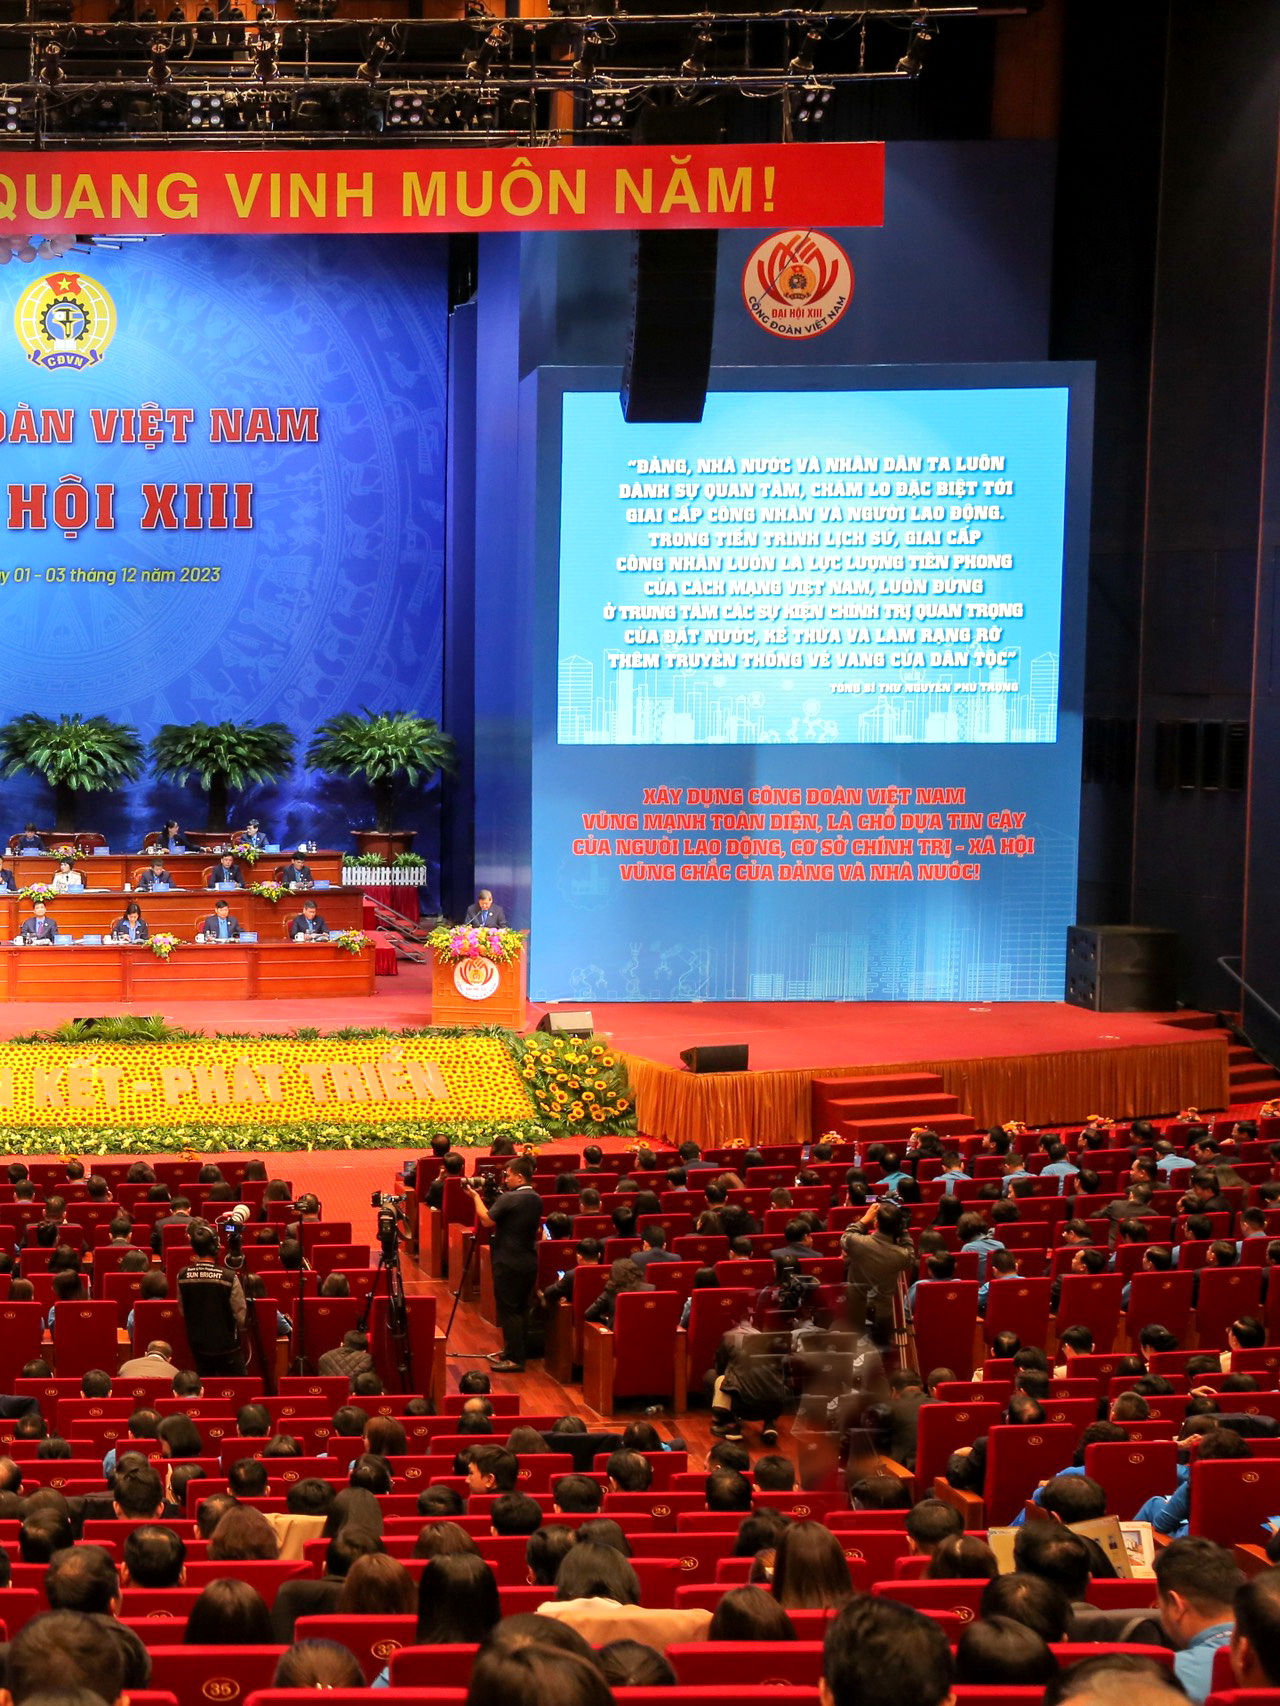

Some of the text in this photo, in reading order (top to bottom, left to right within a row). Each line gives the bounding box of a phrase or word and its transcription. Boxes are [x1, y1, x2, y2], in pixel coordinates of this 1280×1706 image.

[225, 173, 372, 218] VINH
[403, 157, 585, 216] MUÔN
[616, 155, 774, 213] NĂM!
[748, 296, 770, 324] CÔNG
[770, 321, 802, 335] ĐOÀN
[827, 296, 846, 320] NAM
[772, 307, 822, 320] ĐẠI HỘI XIII
[47, 355, 83, 367] CĐVN
[90, 402, 193, 449] VIỆT
[210, 408, 318, 442] NAM
[698, 456, 736, 474] NHÀ
[741, 456, 791, 473] NƯỚC
[796, 456, 820, 473] VÀ
[826, 455, 879, 473] NHÂN
[884, 455, 922, 473] DÂN
[927, 458, 951, 472] TA
[956, 455, 1005, 472] LUÔN
[8, 474, 114, 538] HỘI
[141, 484, 252, 528] XIII
[649, 532, 709, 547] TRONG
[715, 526, 758, 546] TIẾN
[763, 529, 819, 546] TRÌNH
[824, 531, 865, 549] LỊCH
[905, 531, 941, 545] GIAI
[14, 567, 31, 583] 01
[45, 567, 67, 583] 03
[70, 566, 118, 586] tháng
[121, 567, 137, 583] 12
[141, 566, 177, 583] năm
[179, 567, 222, 583] 2023
[643, 786, 966, 809] XÂY DỰNG CÔNG ĐOÀN VIỆT NAM
[582, 810, 1026, 833] VỮNG MẠNH TOÀN DIỆN, LÀ CHỖ DỰA TIN CẬY
[573, 835, 611, 856] CỦA
[615, 837, 679, 856] NGƯỜI
[683, 840, 722, 856] LAO
[726, 836, 786, 858] ĐỘNG,
[791, 839, 818, 856] CƠ
[821, 836, 849, 856] SỞ
[852, 836, 914, 856] CHÍNH
[917, 838, 952, 857] TRỊ
[969, 836, 996, 854] XÃ
[1000, 836, 1034, 856] HỘI
[619, 860, 980, 881] VỮNG CHẮC CỦA ĐẢNG VÀ NHÀ NƯỚC!
[33, 1055, 124, 1108] KẾT
[164, 1055, 286, 1106] PHÁT
[301, 1045, 449, 1102] TRIỂN
